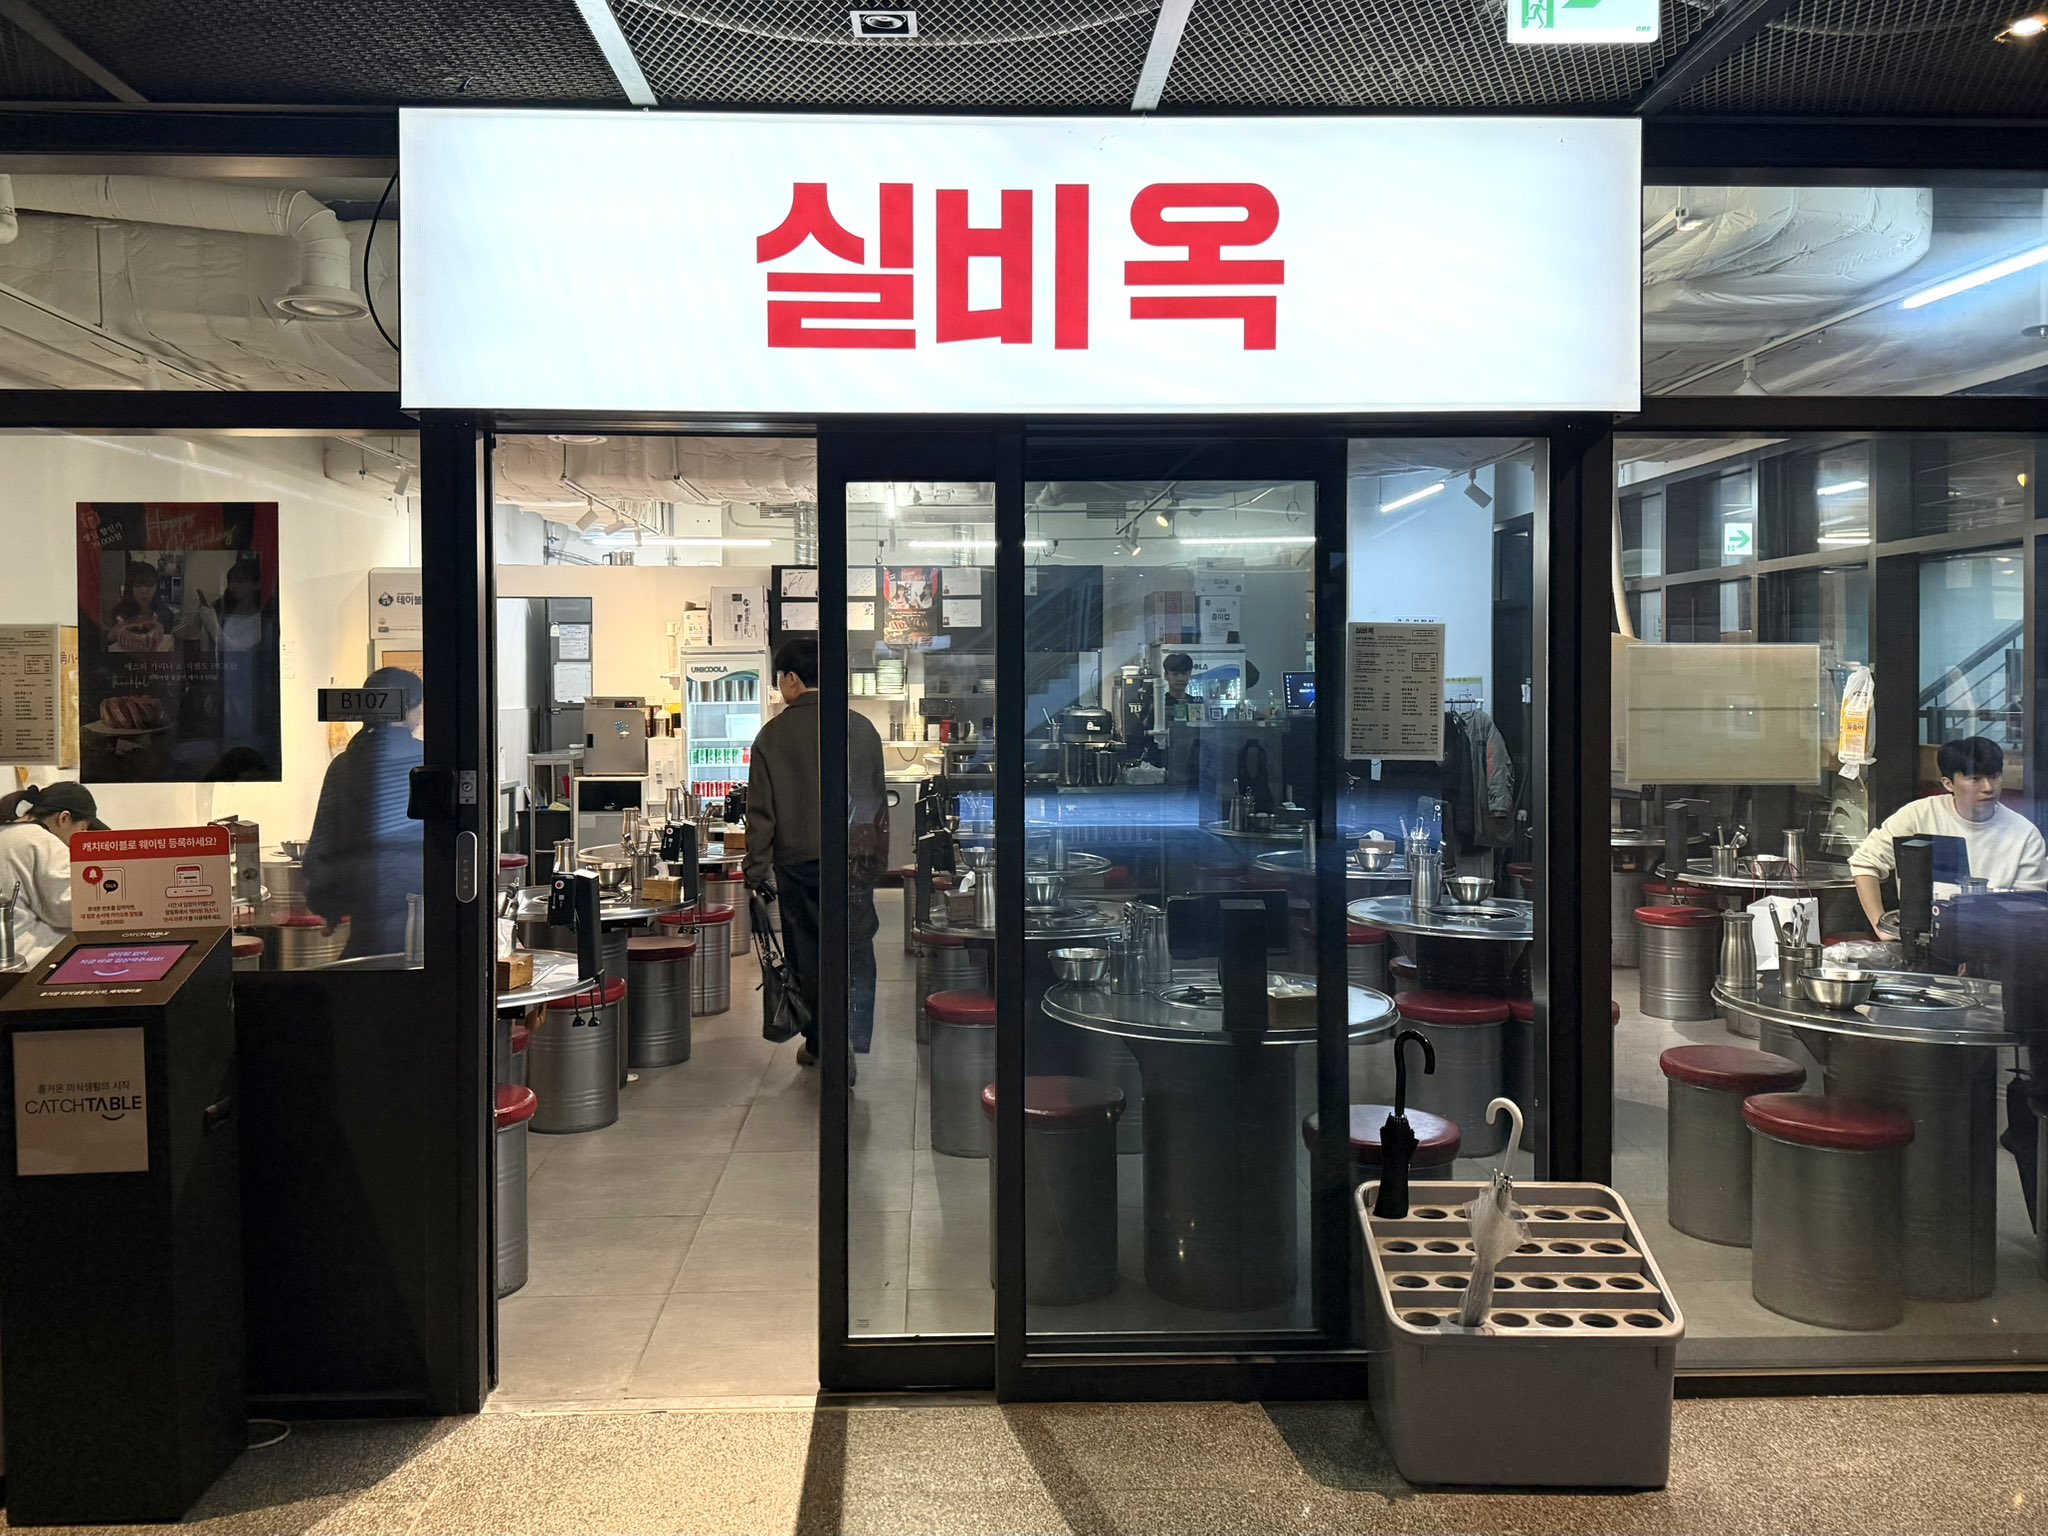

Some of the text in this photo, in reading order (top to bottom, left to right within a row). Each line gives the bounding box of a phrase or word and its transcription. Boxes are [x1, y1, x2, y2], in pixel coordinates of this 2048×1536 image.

[757, 182, 1285, 350] 실비옥
[341, 692, 388, 709] B107
[82, 836, 217, 852] 캐치테이블로 웨이팅 등록하세요!
[38, 1080, 130, 1094] 즐거운 미식생활의 시작
[25, 1095, 142, 1115] CATCHTABLE
